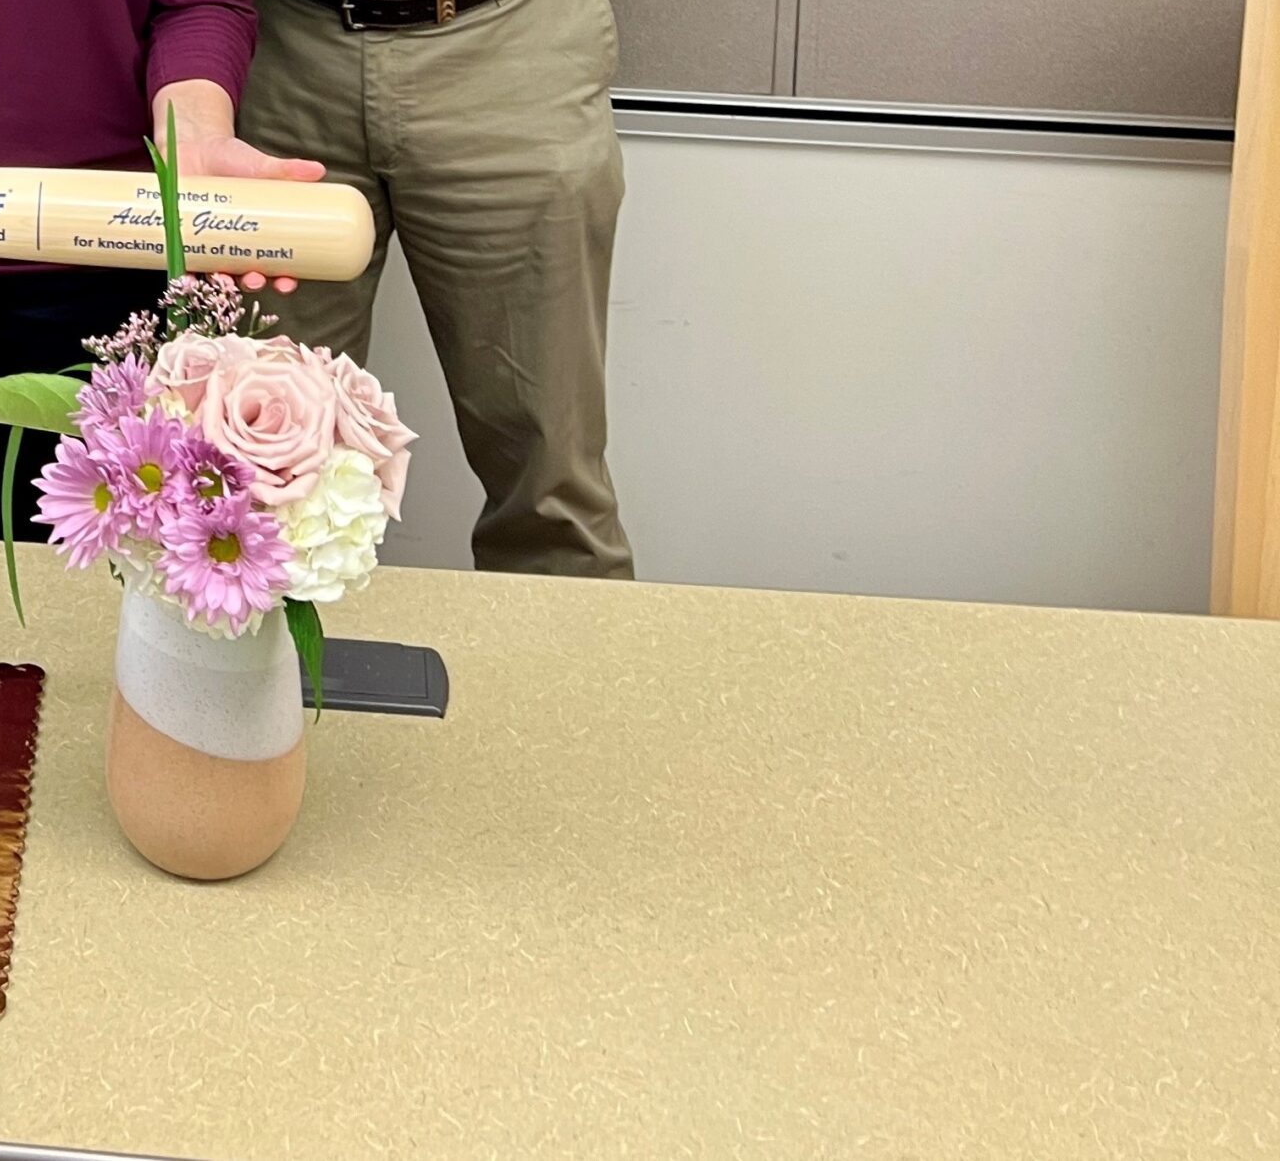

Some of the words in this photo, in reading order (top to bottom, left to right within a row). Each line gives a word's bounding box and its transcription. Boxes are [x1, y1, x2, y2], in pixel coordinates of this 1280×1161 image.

[136, 188, 209, 203] Prented
[74, 236, 94, 247] for
[97, 237, 164, 254] knocking
[181, 245, 207, 255] out
[210, 244, 226, 256] of
[229, 245, 252, 258] the
[256, 248, 294, 260] park!
